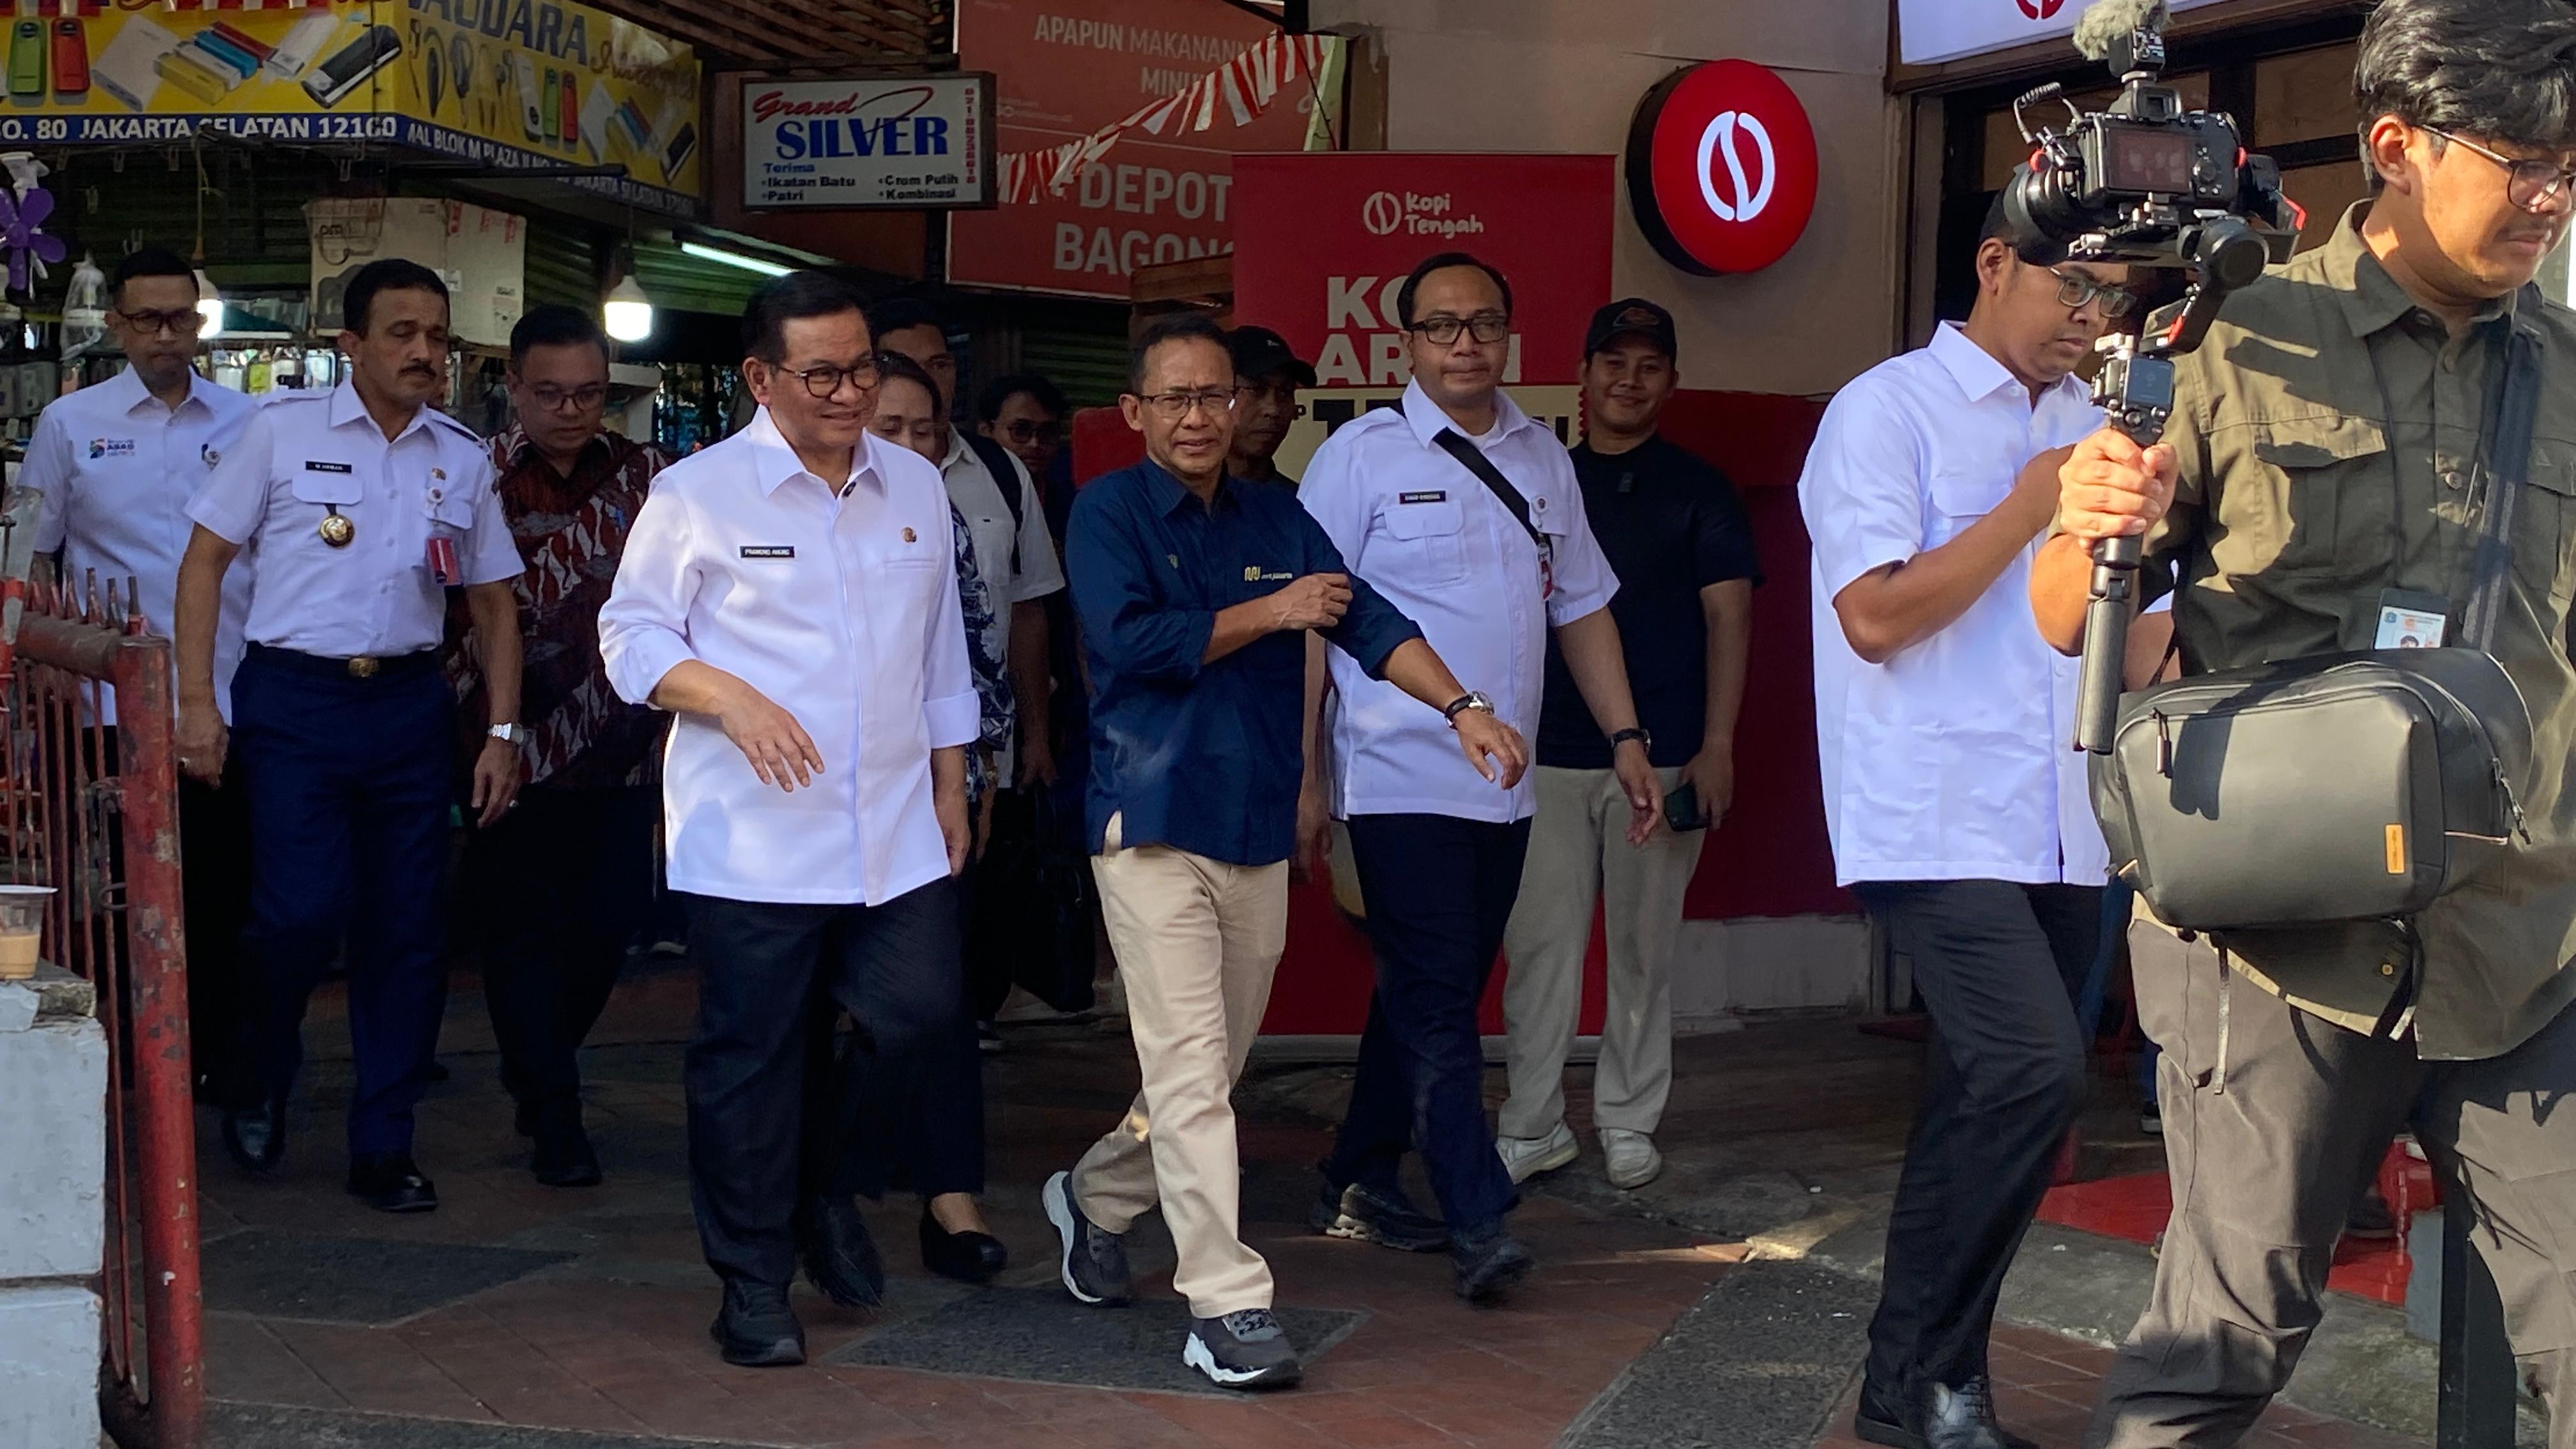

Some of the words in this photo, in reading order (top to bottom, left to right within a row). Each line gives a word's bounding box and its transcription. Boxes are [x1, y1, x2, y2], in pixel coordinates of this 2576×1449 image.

[408, 0, 588, 65] UDARA
[1035, 14, 1124, 52] APAPUN
[753, 91, 859, 123] Grand
[0, 118, 29, 141] O.
[36, 118, 66, 140] 80
[79, 118, 192, 140] JAKARTA
[318, 116, 397, 139] 12160
[776, 117, 948, 160] SILVER
[434, 128, 466, 156] BLOK
[468, 137, 480, 160] M
[483, 142, 521, 168] PLAZA
[763, 162, 815, 173] Terima
[768, 176, 816, 187] Ikatan
[820, 176, 855, 187] Batu
[925, 174, 958, 184] Putih
[768, 190, 804, 201] Patri
[1080, 162, 1234, 222] DEPOT
[1406, 192, 1451, 212] Kopi
[1404, 215, 1484, 240] Tengah
[1054, 222, 1234, 276] BAGO
